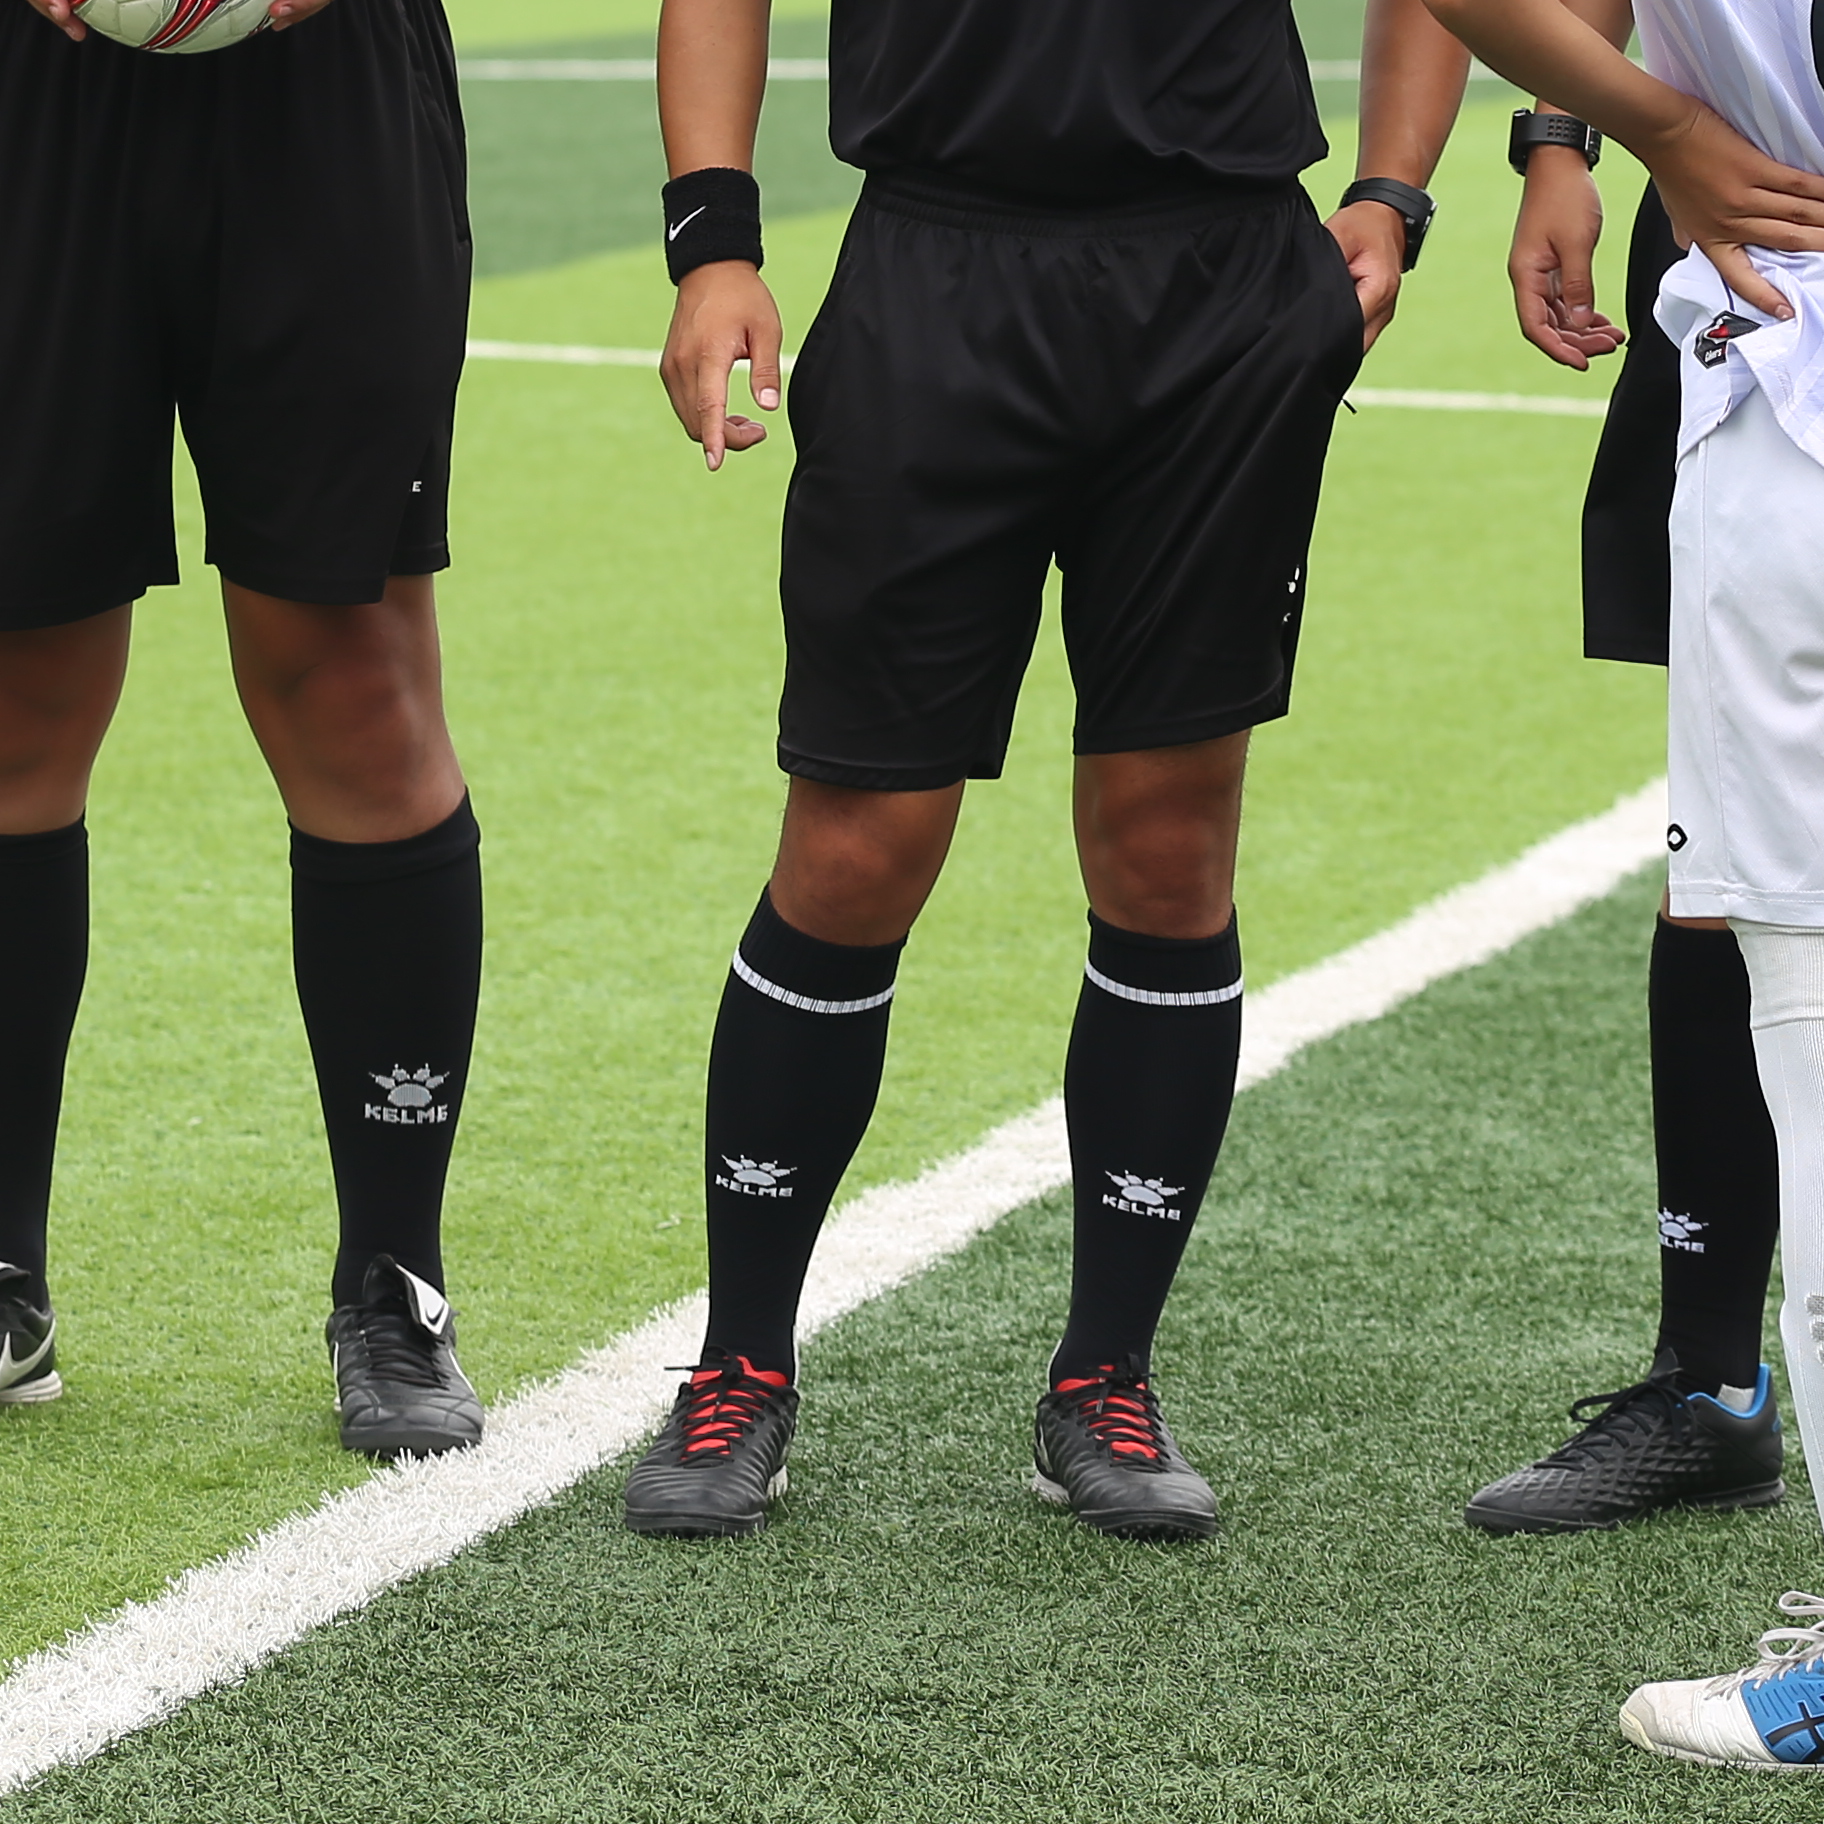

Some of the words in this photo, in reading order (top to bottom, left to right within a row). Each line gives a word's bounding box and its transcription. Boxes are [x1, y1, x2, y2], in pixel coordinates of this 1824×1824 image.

[364, 1102, 449, 1125] KELME
[715, 1173, 793, 1198] KELME
[1101, 1194, 1181, 1221] KELME
